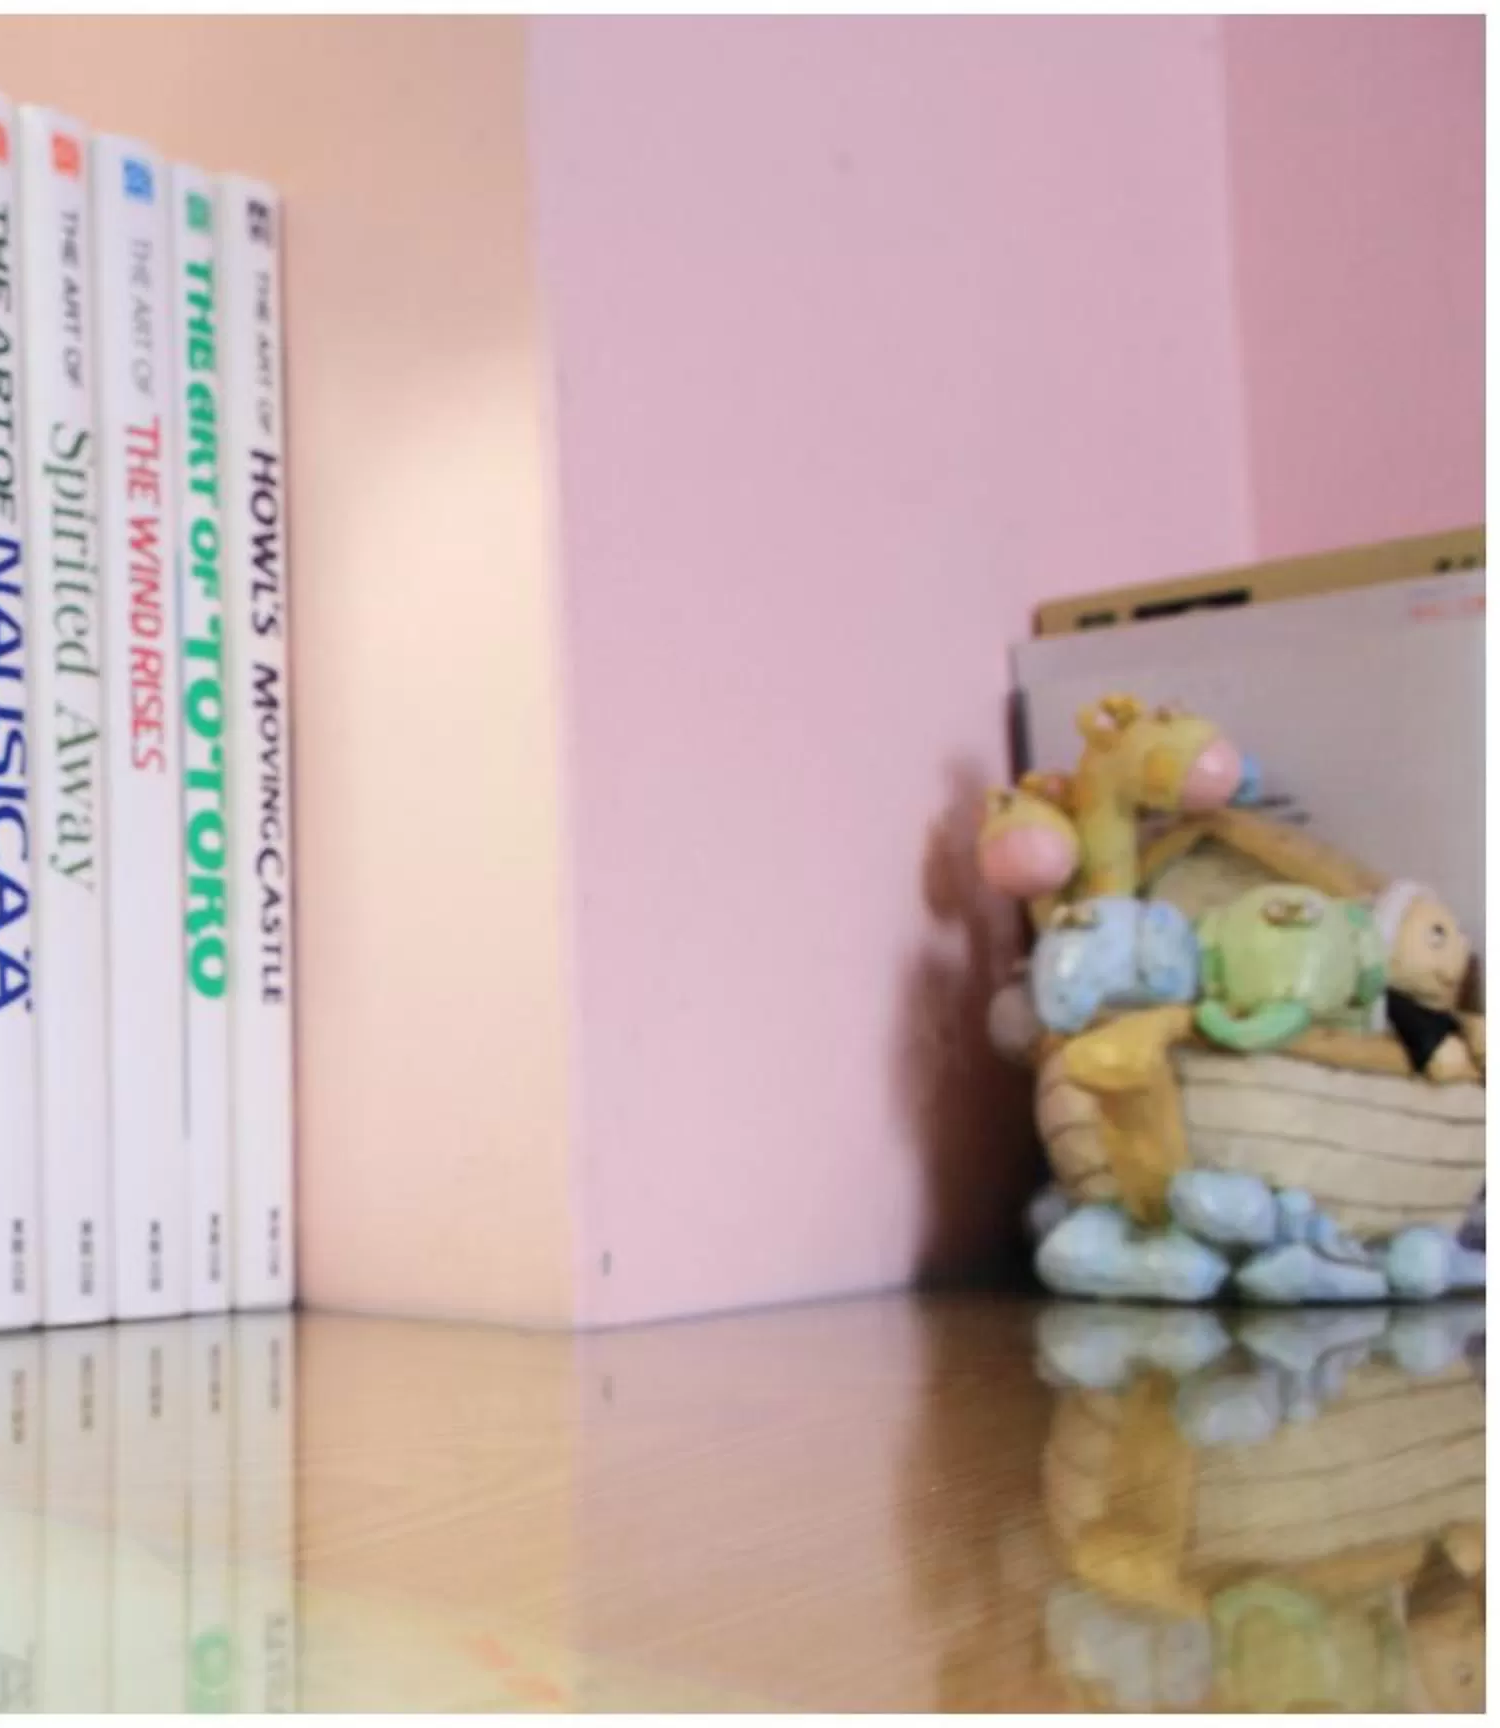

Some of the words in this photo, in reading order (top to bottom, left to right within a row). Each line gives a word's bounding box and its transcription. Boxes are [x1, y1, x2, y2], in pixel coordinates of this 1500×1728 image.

[60, 210, 80, 268] THE
[130, 236, 153, 293] THE
[61, 276, 83, 343] ART
[131, 299, 154, 353] ART
[184, 258, 216, 374] THE
[61, 347, 85, 391] OF
[131, 357, 155, 398] OF
[124, 415, 162, 507] THE
[41, 421, 101, 679] Spirited
[127, 514, 165, 648] WIND
[188, 516, 222, 600] OF
[249, 449, 282, 638] HOWL'S
[129, 646, 167, 774] RISES
[251, 662, 285, 842] MOVING
[48, 702, 101, 895] Away
[181, 613, 228, 1000] TOTORO
[255, 845, 287, 1006] CASTLE
